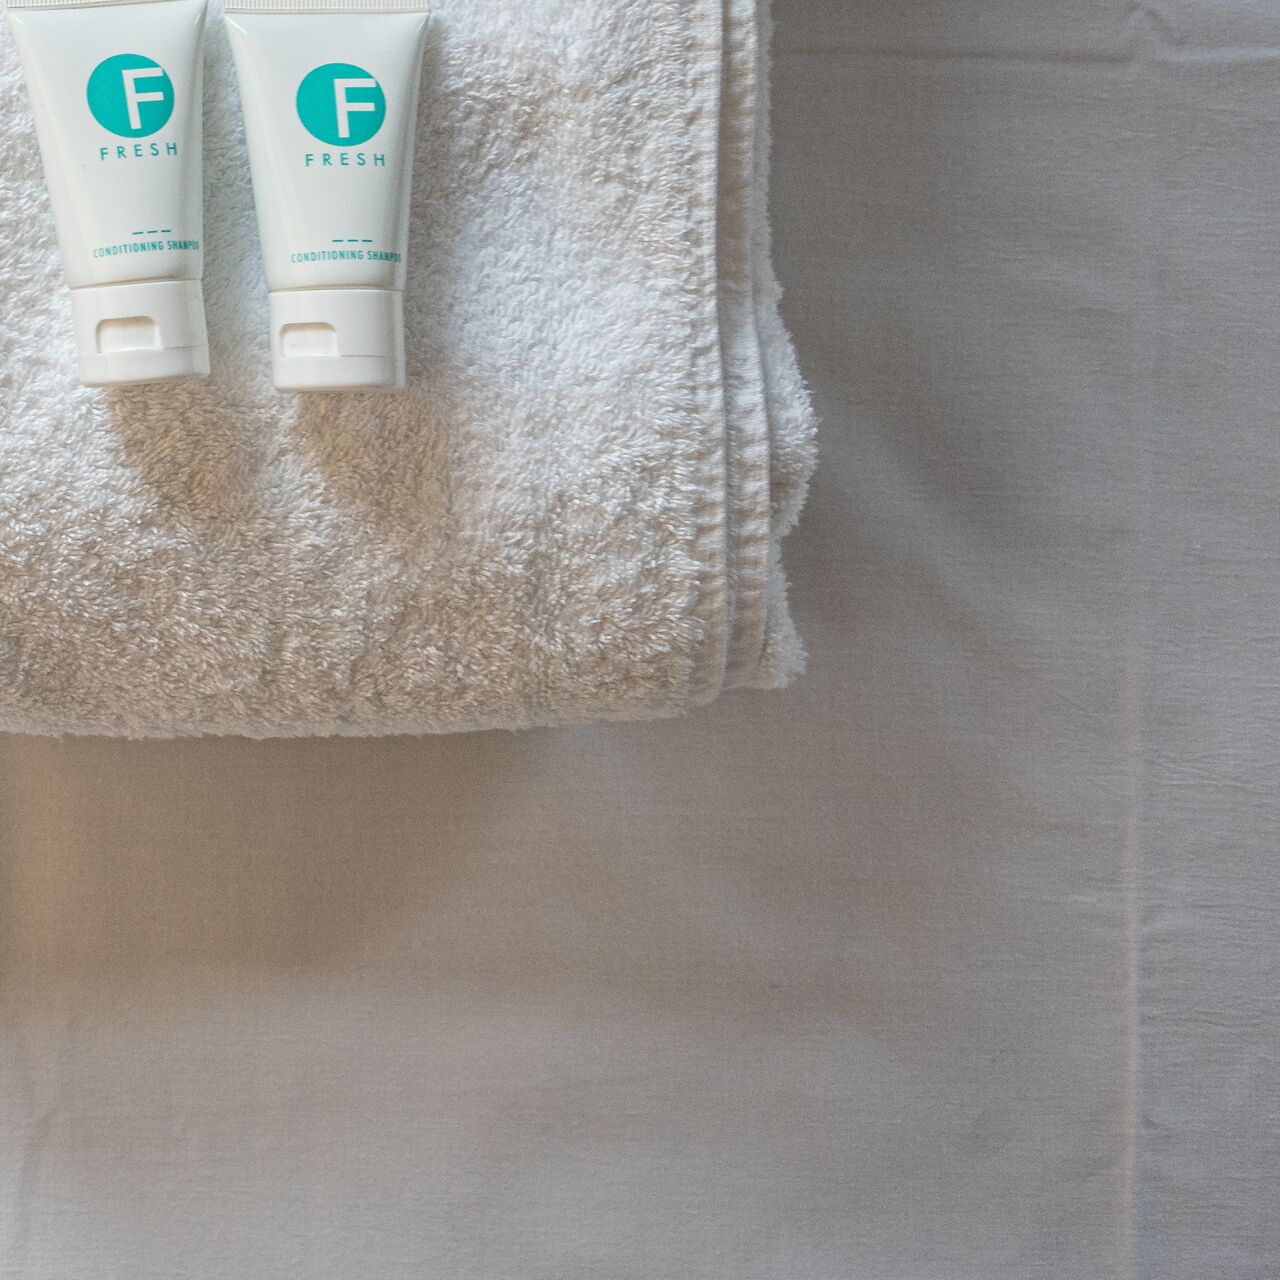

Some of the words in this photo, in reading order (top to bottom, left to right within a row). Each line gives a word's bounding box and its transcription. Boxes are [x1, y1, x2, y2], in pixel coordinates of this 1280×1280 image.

[121, 67, 164, 130] F
[333, 77, 377, 138] F
[100, 142, 178, 161] FRESH
[305, 152, 386, 167] FRESH
[93, 241, 164, 258] CONDITIONING
[291, 250, 364, 263] CONDITIONING
